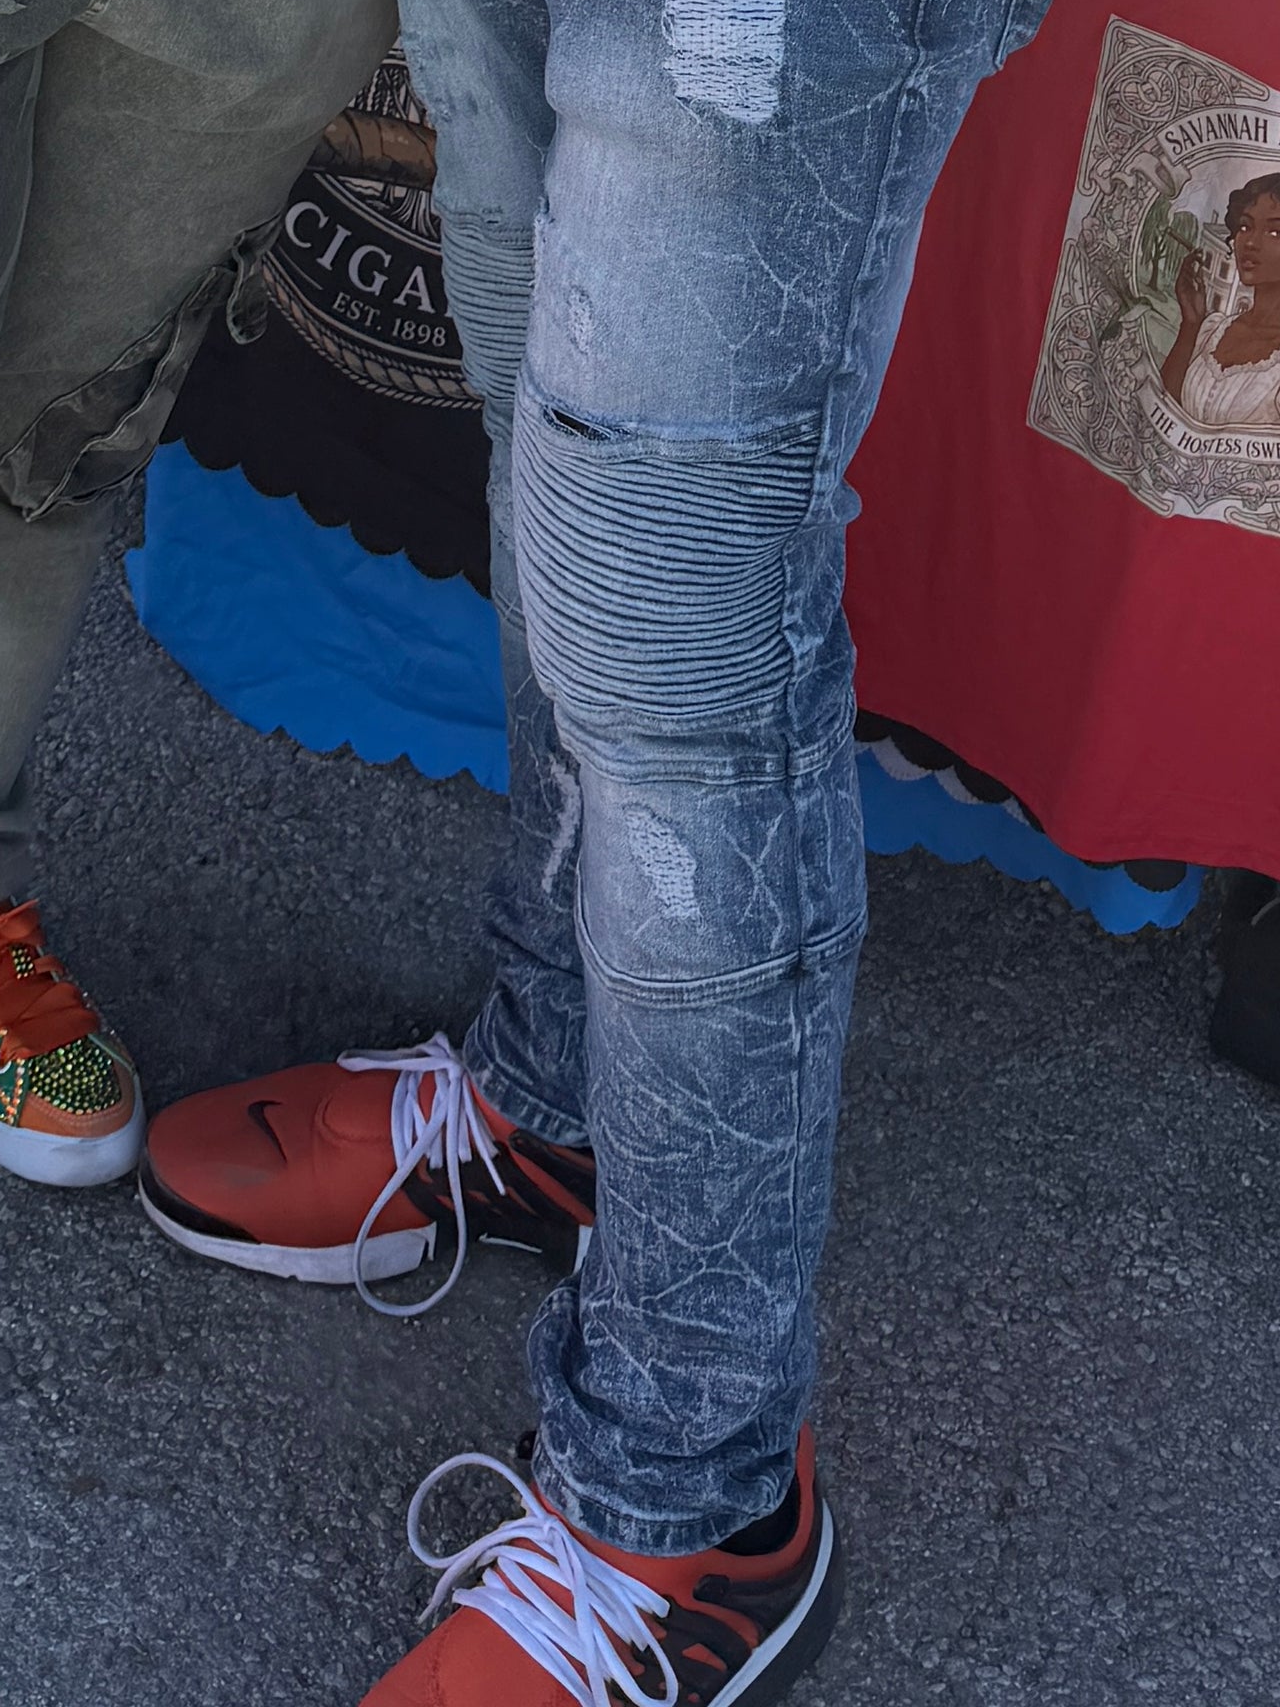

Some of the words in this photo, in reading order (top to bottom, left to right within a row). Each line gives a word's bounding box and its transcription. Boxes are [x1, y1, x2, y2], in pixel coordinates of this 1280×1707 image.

[1165, 112, 1269, 157] SAVANNAH
[283, 200, 453, 318] CIGA
[332, 292, 381, 333] EST.
[393, 316, 446, 348] 1898
[1149, 402, 1175, 440] THE
[1178, 432, 1243, 456] HOSTESS
